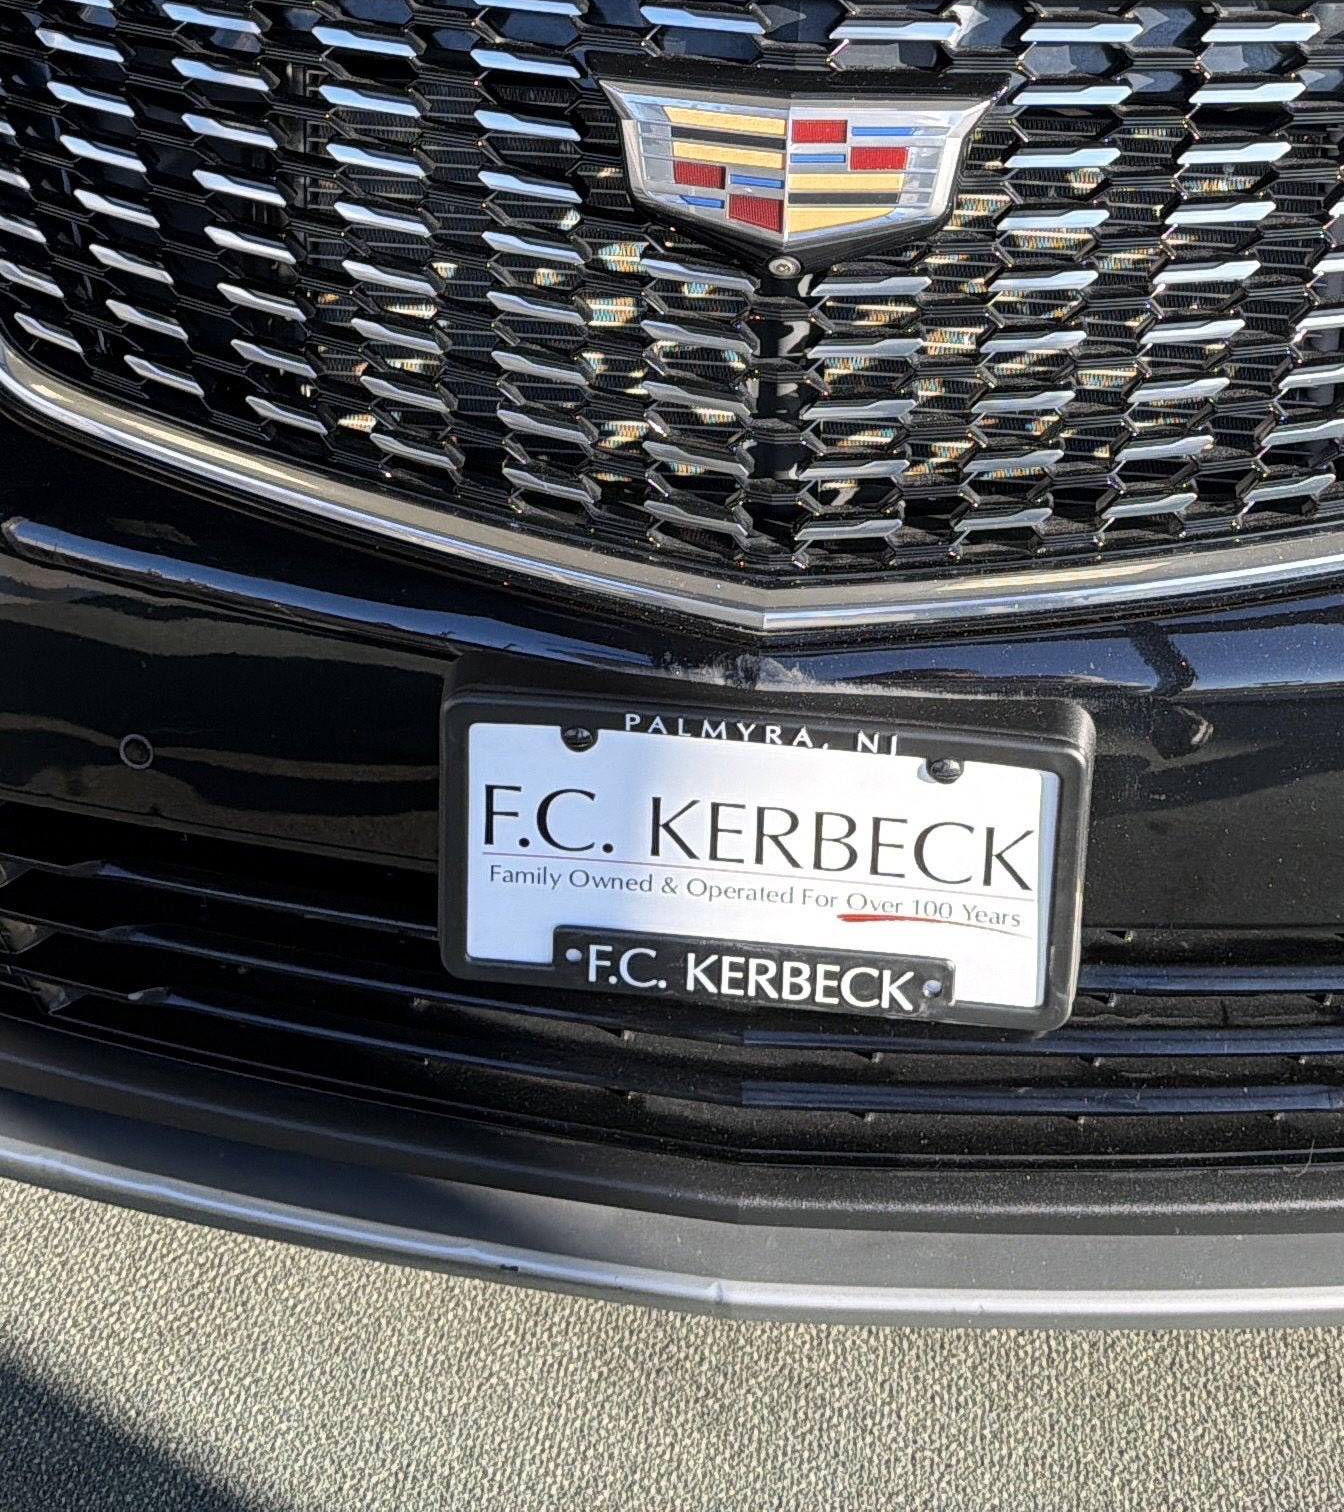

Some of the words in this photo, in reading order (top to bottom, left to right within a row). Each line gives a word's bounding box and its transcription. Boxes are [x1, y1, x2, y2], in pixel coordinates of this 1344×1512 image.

[624, 712, 829, 751] PALMYRA,
[482, 783, 616, 855] F.C.
[650, 796, 1037, 892] KERBECK
[489, 863, 562, 891] Family
[568, 868, 654, 893] Owned
[661, 876, 678, 895] &
[686, 877, 794, 905] Operated
[801, 887, 838, 909] For
[846, 892, 904, 914] Over
[912, 898, 954, 920] 100
[961, 903, 1022, 928] Years
[585, 943, 668, 990] F.C.
[686, 952, 916, 1012] KERBECK
